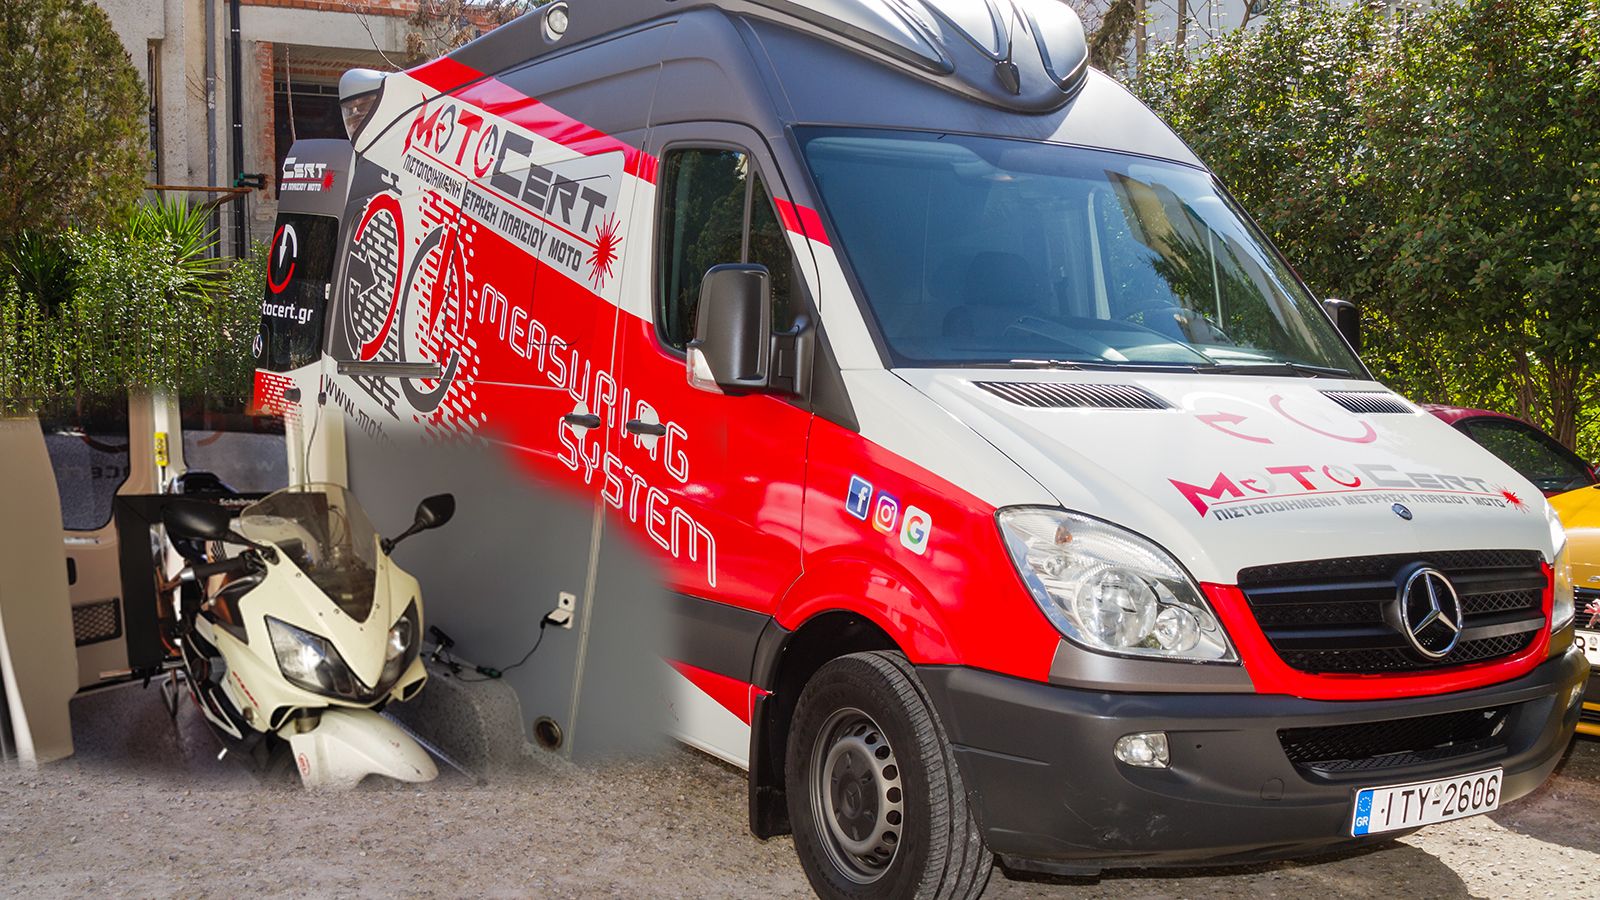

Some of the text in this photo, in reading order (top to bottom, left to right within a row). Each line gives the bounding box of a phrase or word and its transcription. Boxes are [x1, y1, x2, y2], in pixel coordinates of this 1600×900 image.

[401, 92, 608, 234] MOTOCERT
[462, 182, 500, 226] ΕΤΡΗΣΗ
[557, 416, 717, 588] SYSTEM
[1355, 815, 1369, 828] GR
